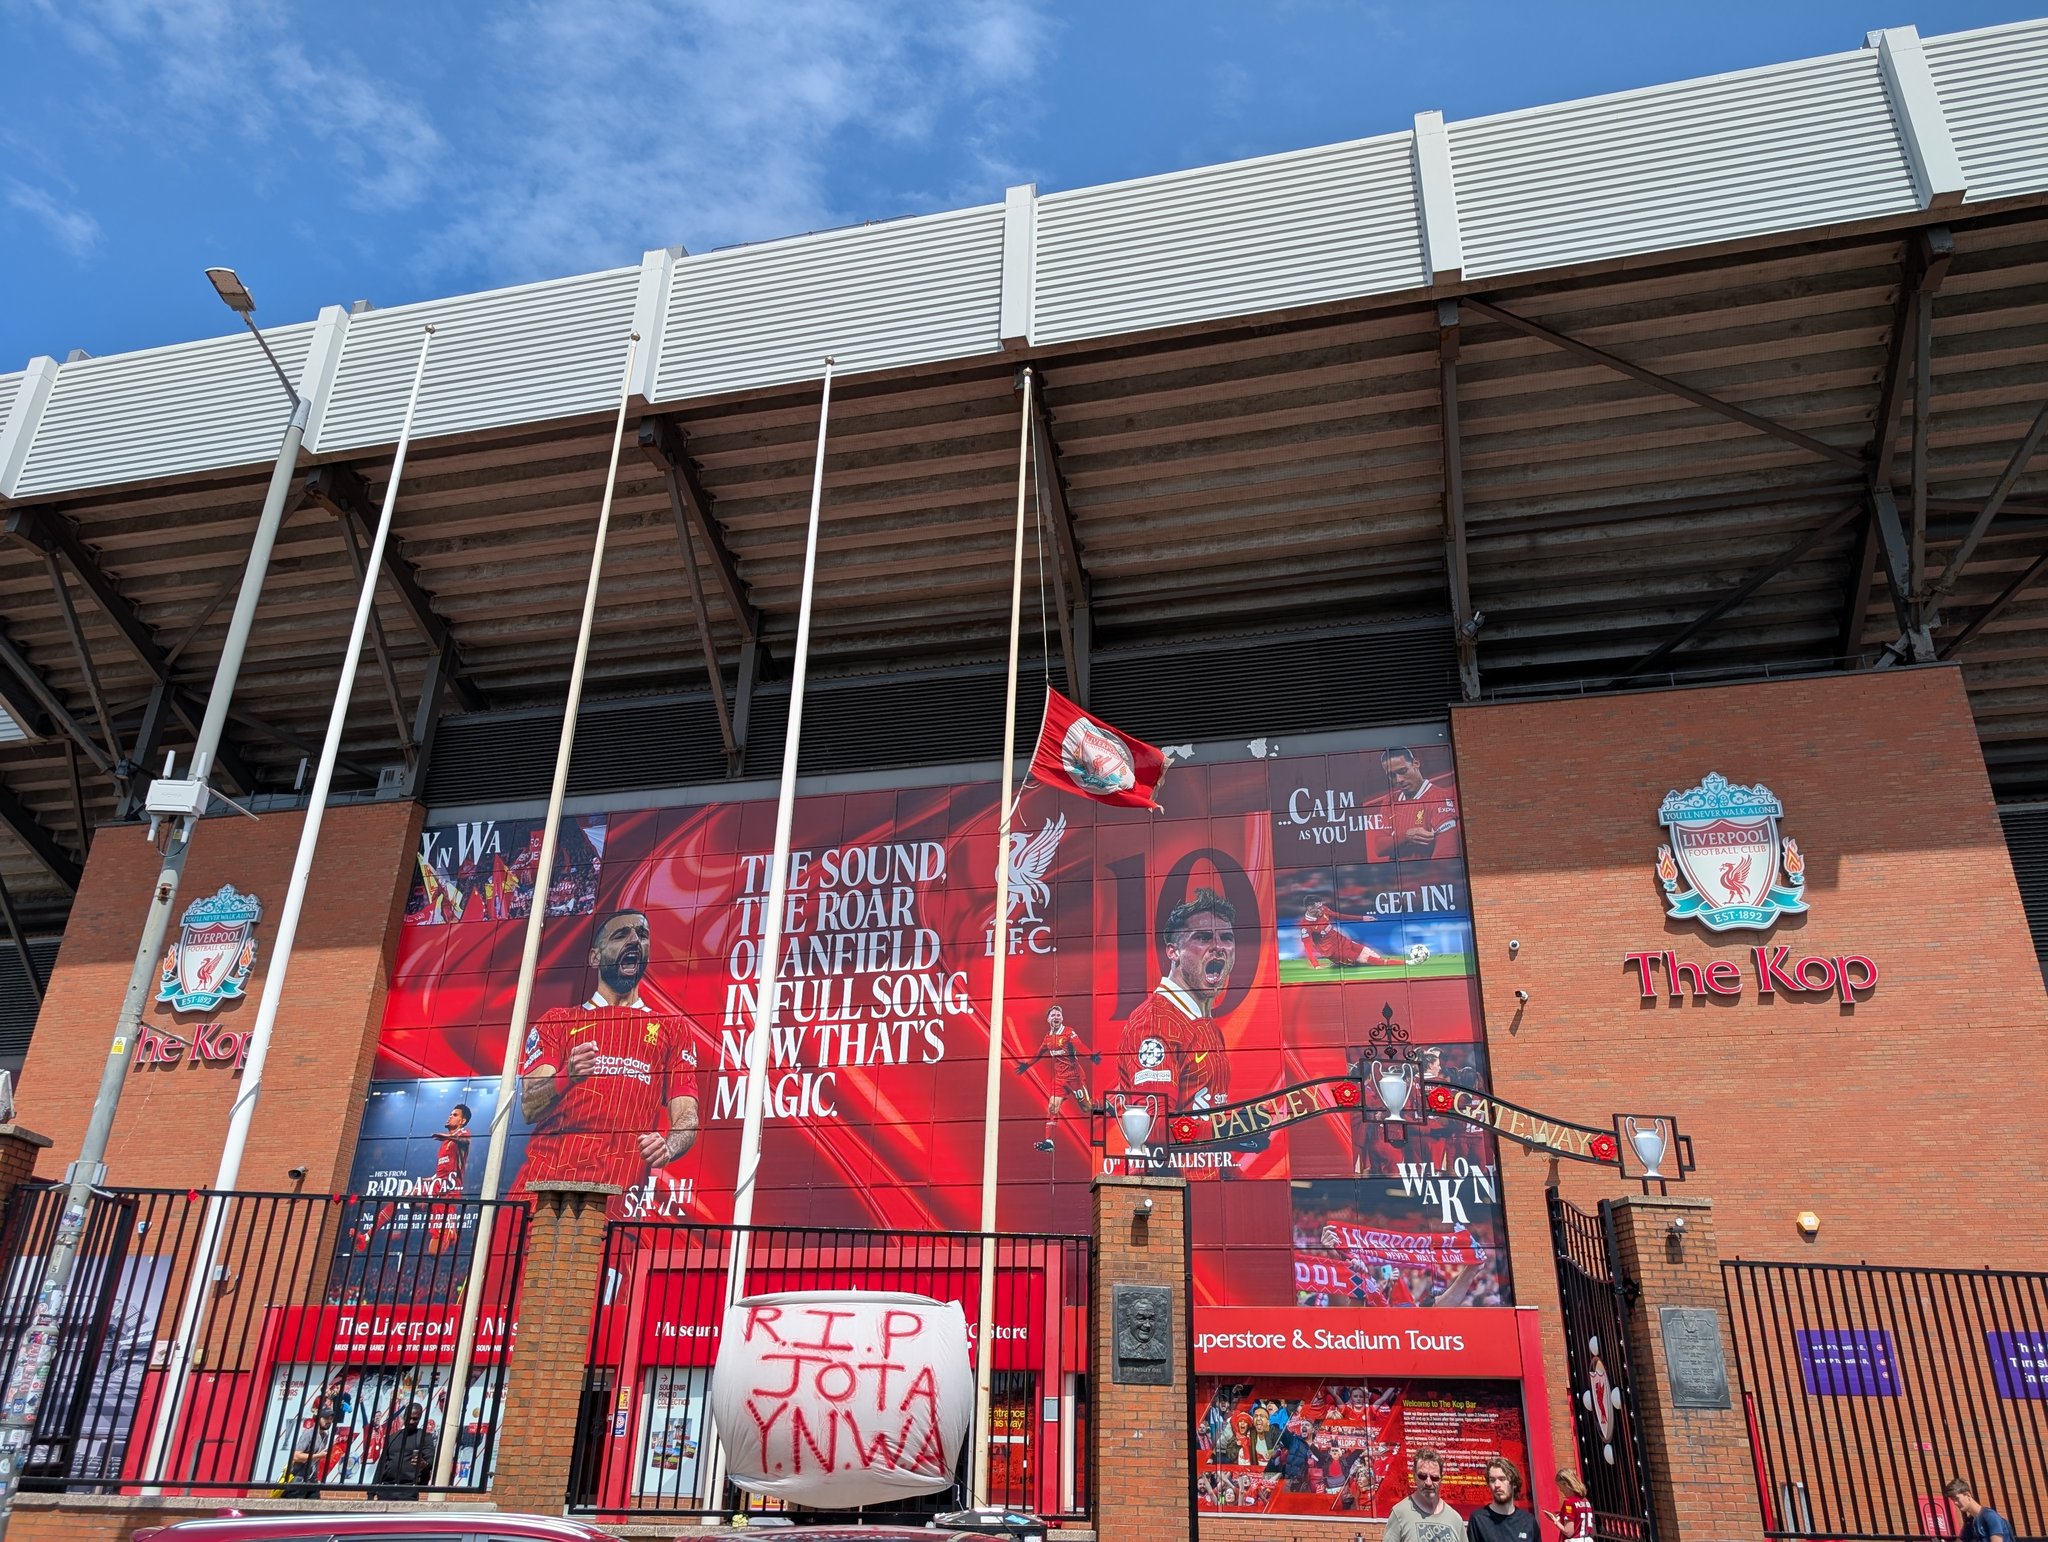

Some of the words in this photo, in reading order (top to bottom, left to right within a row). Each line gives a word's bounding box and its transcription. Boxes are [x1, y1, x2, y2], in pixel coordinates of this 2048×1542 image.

[1664, 811, 1693, 820] YOU'LL
[1693, 809, 1721, 819] NEVER
[1722, 808, 1748, 818] WALK
[1748, 805, 1777, 816] ALONE
[1299, 829, 1311, 840] AS
[1311, 826, 1347, 845] YOU
[1348, 814, 1392, 832] LIKE...
[1682, 829, 1769, 847] LIVERPOOL
[1688, 846, 1739, 857] FOOTBALL
[1740, 845, 1767, 854] CLUB
[740, 851, 812, 894] THE
[819, 841, 947, 885] SOUND,
[736, 893, 808, 937] THE
[815, 886, 915, 932] ROAR
[1420, 884, 1456, 912] IN!
[187, 931, 240, 945] LIVERPOOL
[187, 944, 218, 952] FOOTBALL
[984, 926, 1057, 957] LF.C.
[775, 928, 941, 979] ANFIELD
[1624, 948, 1744, 998] The
[1751, 944, 1880, 1005] Kop
[723, 983, 759, 1026] IN
[771, 977, 864, 1024] FULL
[870, 971, 975, 1019] SONG.
[134, 1026, 182, 1064] he
[812, 1018, 945, 1069] THAT'S
[594, 1054, 651, 1073] standard
[711, 1071, 838, 1120] MAGIC.
[1210, 1084, 1322, 1139] PAISLEY
[1453, 1091, 1592, 1155] GATEWAY
[1341, 1227, 1436, 1256] LIVERPOOL
[1442, 1234, 1461, 1254] FC
[1386, 1251, 1410, 1262] NEVER
[1415, 1253, 1437, 1263] WALK
[1441, 1253, 1465, 1263] ALONE
[339, 1317, 370, 1336] The
[373, 1317, 453, 1341] Liverpool
[654, 1321, 719, 1338] Museum
[745, 1306, 923, 1360] R.I.P
[1194, 1332, 1286, 1353] uperstore
[1291, 1329, 1312, 1349] &
[1314, 1329, 1400, 1350] Stadium
[1405, 1330, 1465, 1351] Tours
[334, 1343, 358, 1352] MUSEM
[752, 1354, 938, 1414] JOTA
[657, 1398, 690, 1406] COLECTIO
[1452, 1401, 1464, 1409] Kop
